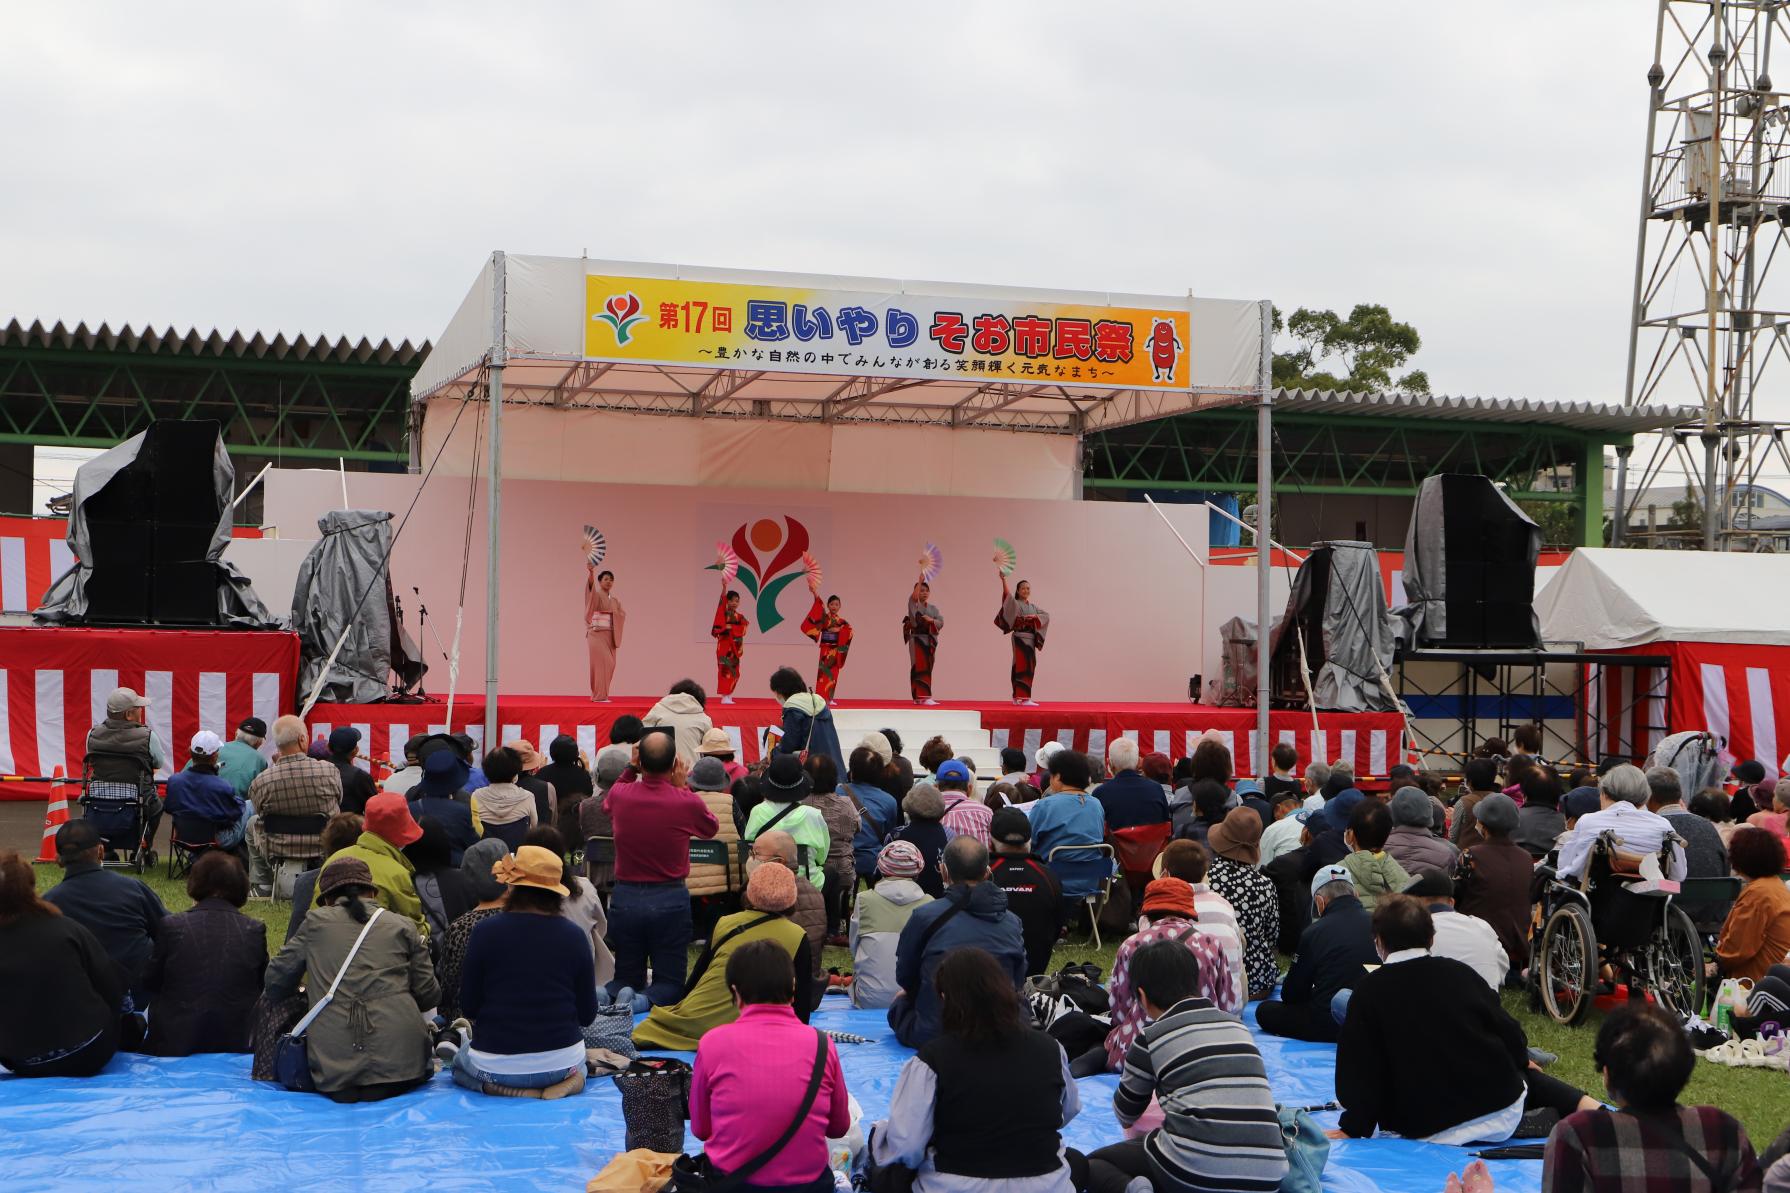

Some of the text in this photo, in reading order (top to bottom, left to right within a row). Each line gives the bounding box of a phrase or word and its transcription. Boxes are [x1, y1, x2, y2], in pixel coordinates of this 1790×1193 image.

[658, 299, 1135, 364] 第17回 思いやり そお市民祭
